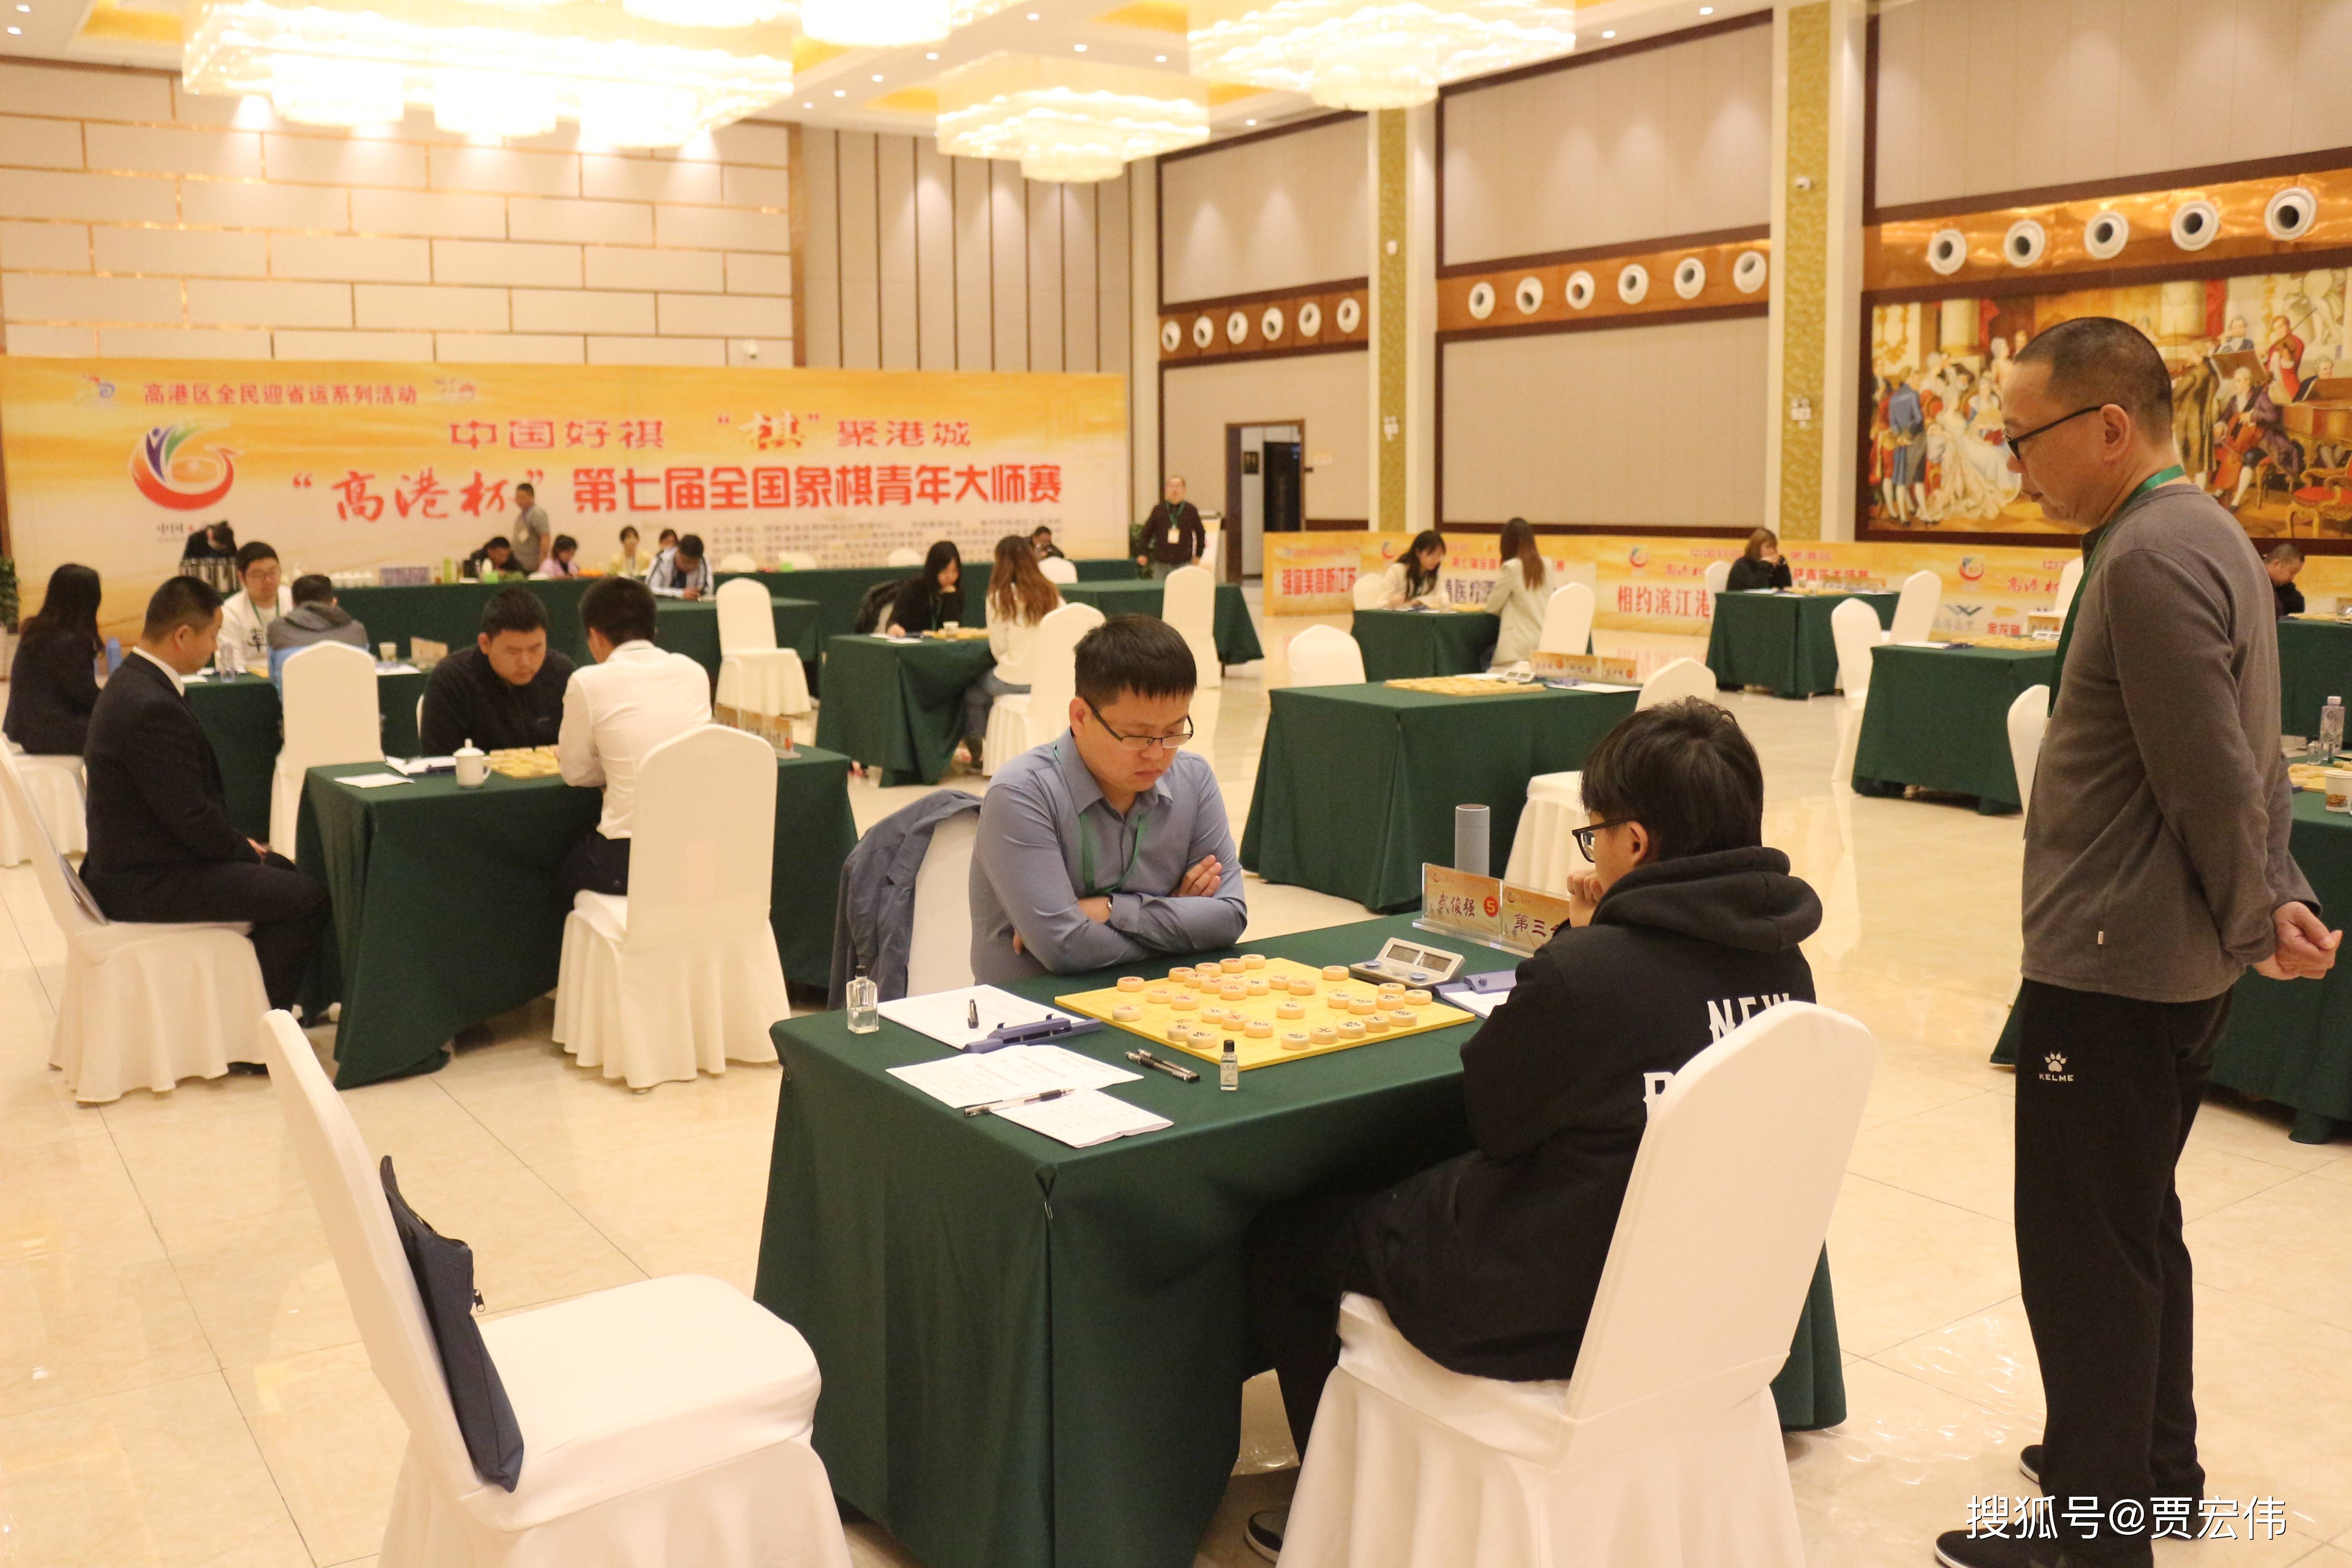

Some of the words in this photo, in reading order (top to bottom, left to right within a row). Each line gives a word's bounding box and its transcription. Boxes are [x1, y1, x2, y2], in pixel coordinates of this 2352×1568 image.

[143, 382, 417, 405] 高港区全民迎省运系列活动
[573, 464, 1061, 513] 第七届全国象棋青年大师赛
[1437, 890, 1475, 917] 武俊强
[1514, 913, 1560, 938] 第三
[2038, 1073, 2074, 1082] KELME
